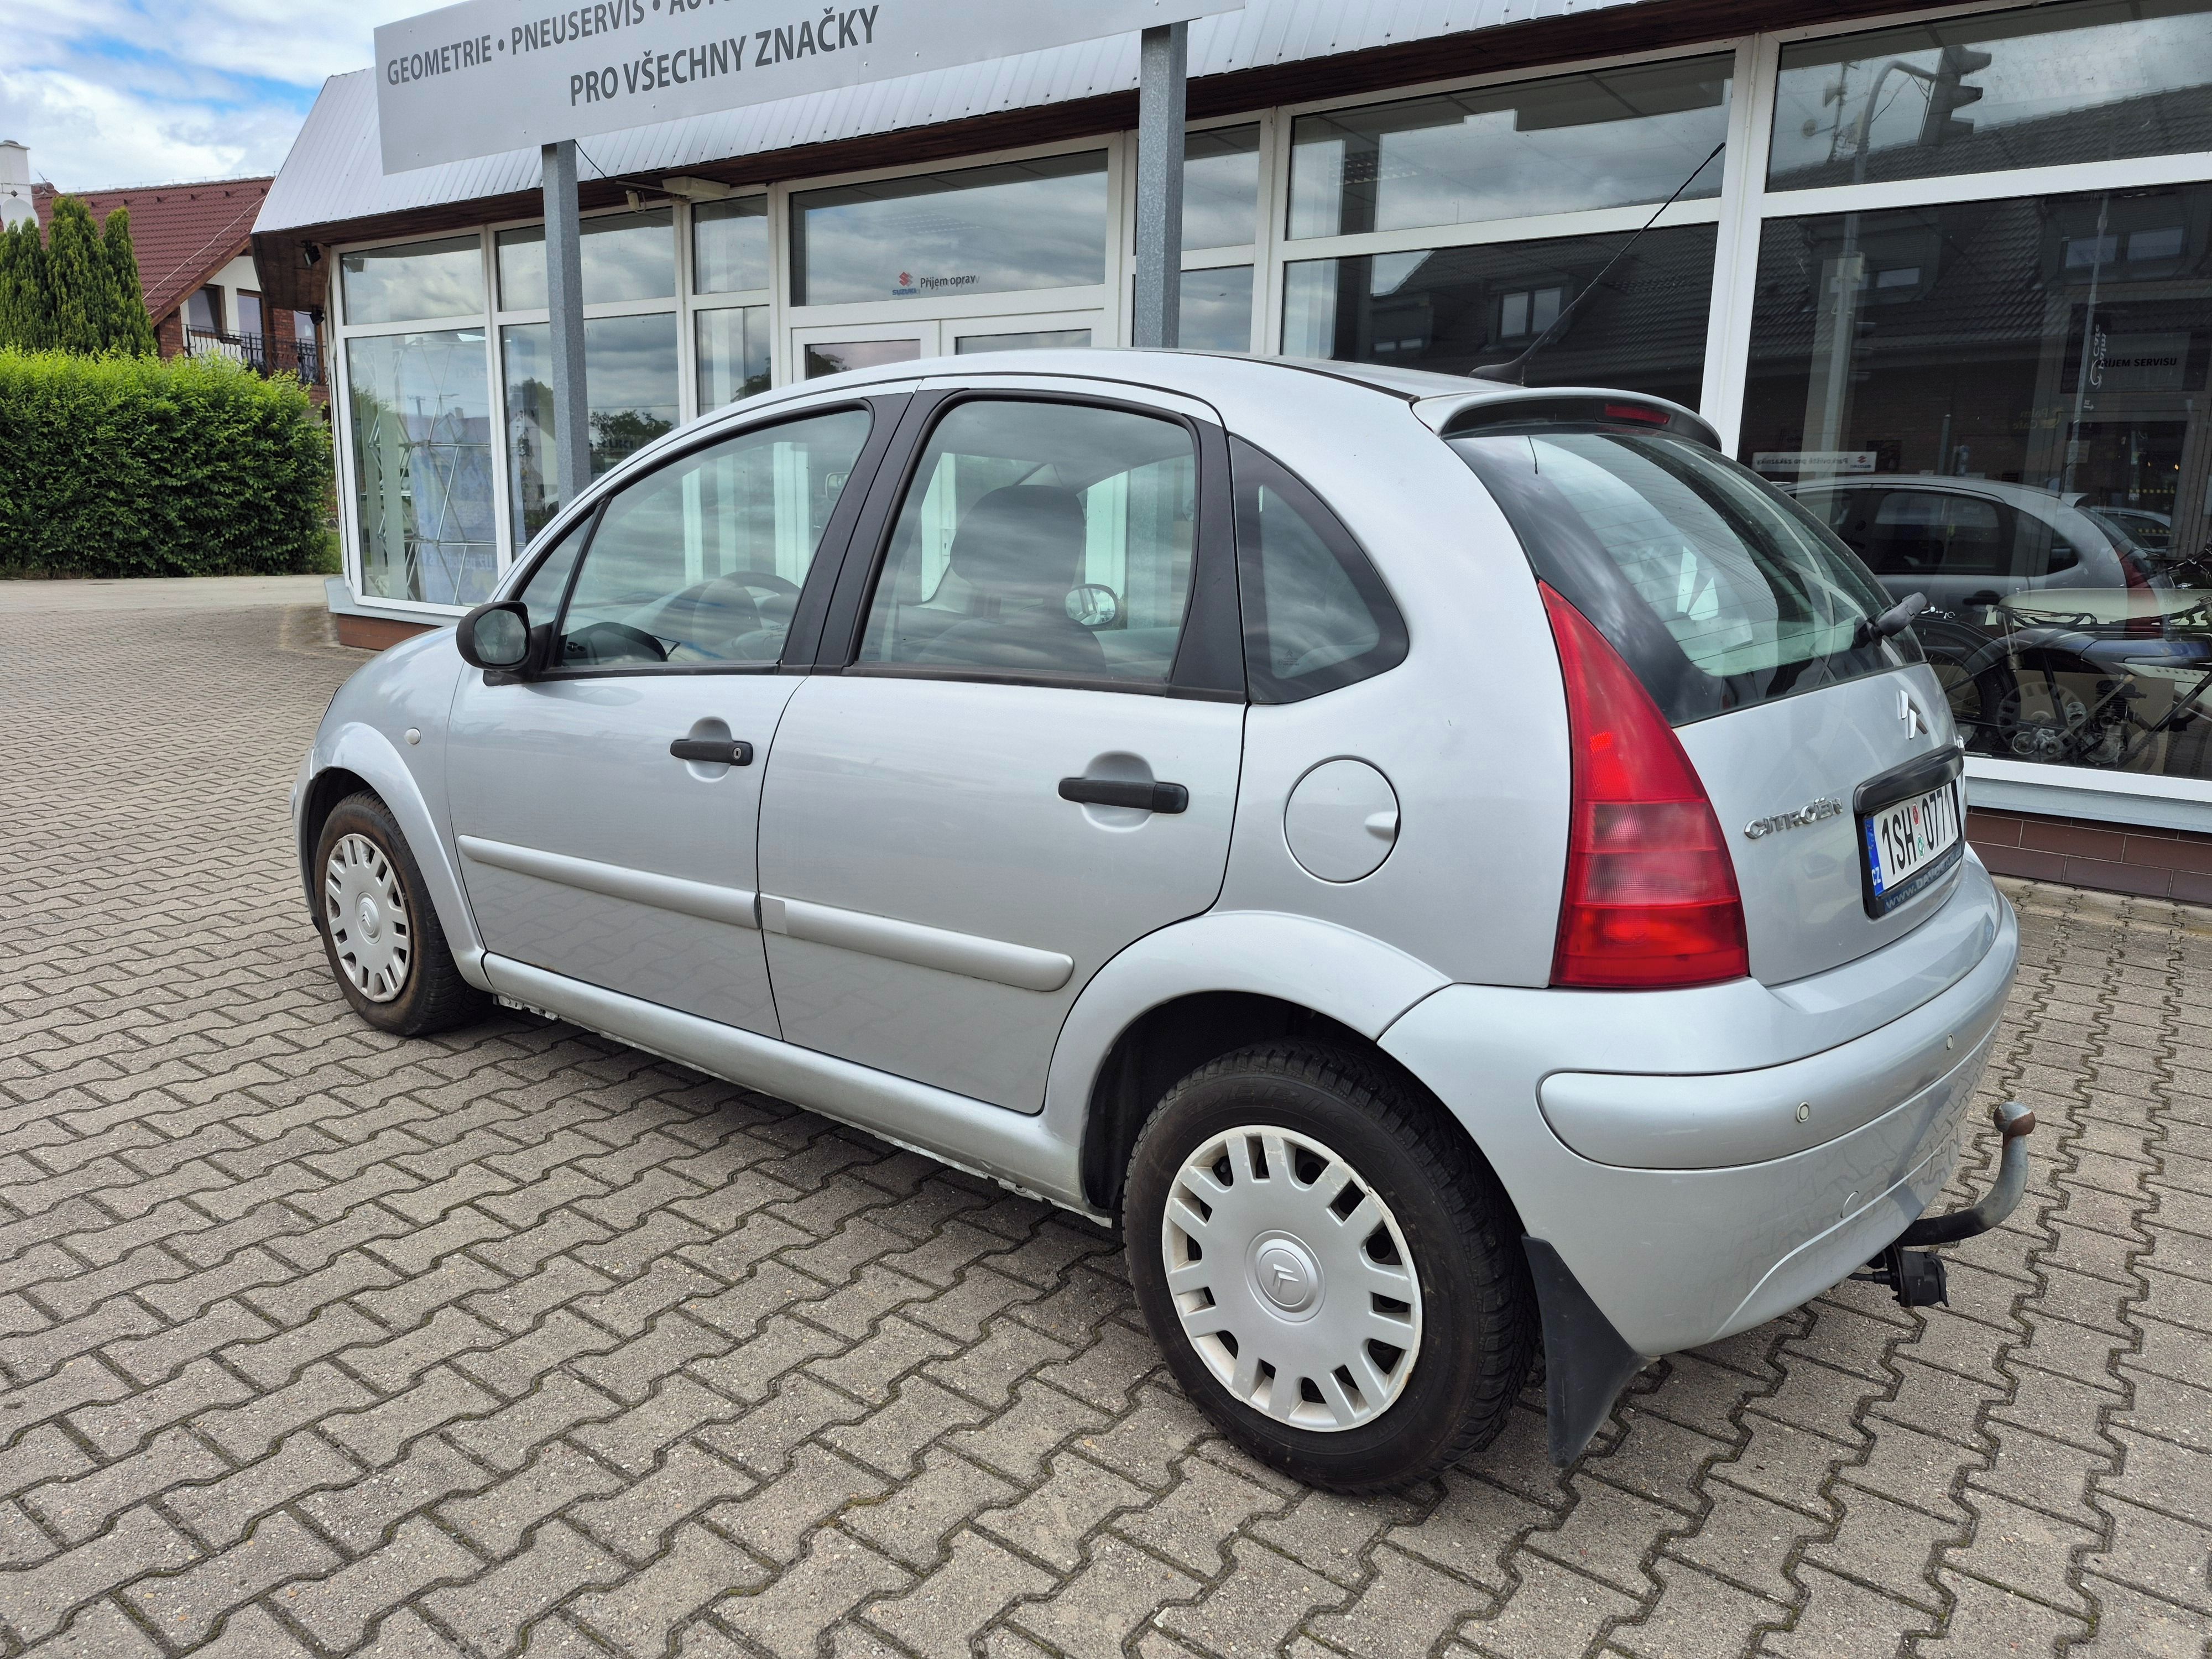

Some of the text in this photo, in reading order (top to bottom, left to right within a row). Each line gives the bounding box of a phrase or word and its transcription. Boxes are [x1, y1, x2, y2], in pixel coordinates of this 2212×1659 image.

[388, 0, 645, 85] GEOMETRIE PNEUSERVIS
[571, 4, 879, 106] PRO VŠECHNY ZNAČKY
[950, 275, 975, 287] oprav
[2134, 358, 2177, 367] SERVISU
[1744, 797, 1843, 839] CITROËN
[1882, 807, 1917, 875] 1SH
[1871, 866, 1881, 886] CZ
